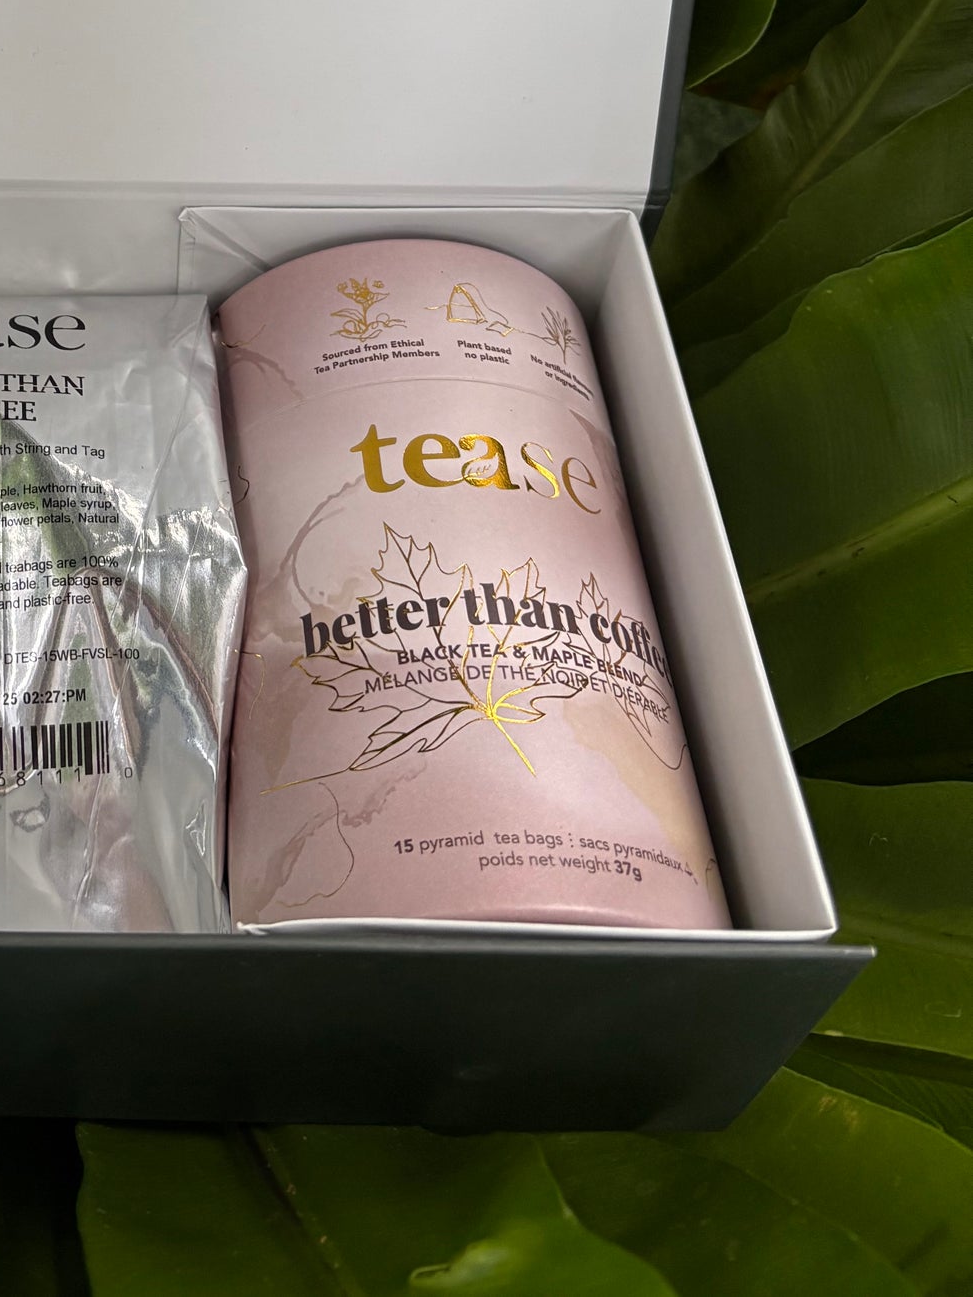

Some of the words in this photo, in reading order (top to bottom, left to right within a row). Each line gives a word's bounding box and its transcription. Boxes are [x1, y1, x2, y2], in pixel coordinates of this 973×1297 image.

[322, 345, 362, 362] Sourced
[363, 342, 388, 353] from
[390, 339, 425, 349] Ethical
[457, 340, 483, 351] Plant
[484, 343, 513, 356] based
[314, 364, 331, 375] Tea
[332, 352, 390, 369] Partnership
[392, 349, 440, 359] Members
[464, 351, 478, 359] no
[480, 352, 511, 366] plastic
[529, 353, 543, 365] No
[544, 361, 572, 379] artificial
[544, 370, 554, 378] or
[15, 443, 51, 457] String
[54, 443, 77, 456] and
[81, 444, 106, 460] Tag
[349, 422, 602, 515] tease
[23, 483, 77, 496] Hawthorn
[1, 501, 39, 514] leaves,
[42, 497, 77, 512] Maple
[78, 512, 120, 525] Natural
[5, 559, 53, 575] teabags
[56, 559, 77, 570] are
[81, 555, 119, 569] 100%
[43, 575, 99, 592] Teabags
[101, 576, 123, 587] are
[23, 592, 95, 610] plastic-free.
[300, 595, 451, 658] better
[461, 582, 581, 636] than
[397, 644, 463, 666] BLACK
[468, 643, 508, 659] TEA
[512, 645, 526, 659] &
[532, 646, 594, 670] MAPLE
[597, 658, 645, 687] BLEND
[365, 665, 461, 694] MÉLANGE
[467, 665, 493, 680] DE
[497, 662, 536, 682] THÉ
[541, 668, 587, 688] NOIR
[590, 676, 608, 694] ET
[22, 688, 87, 706] 02:27:PM
[394, 838, 414, 855] 15
[418, 830, 484, 854] pyramid
[493, 831, 520, 845] tea
[524, 830, 564, 849] bags
[579, 837, 610, 851] sacs
[613, 842, 684, 872] pyramidaux
[478, 851, 524, 871] poids
[528, 854, 556, 867] net
[558, 854, 612, 874] weight
[613, 859, 643, 882] 37g
